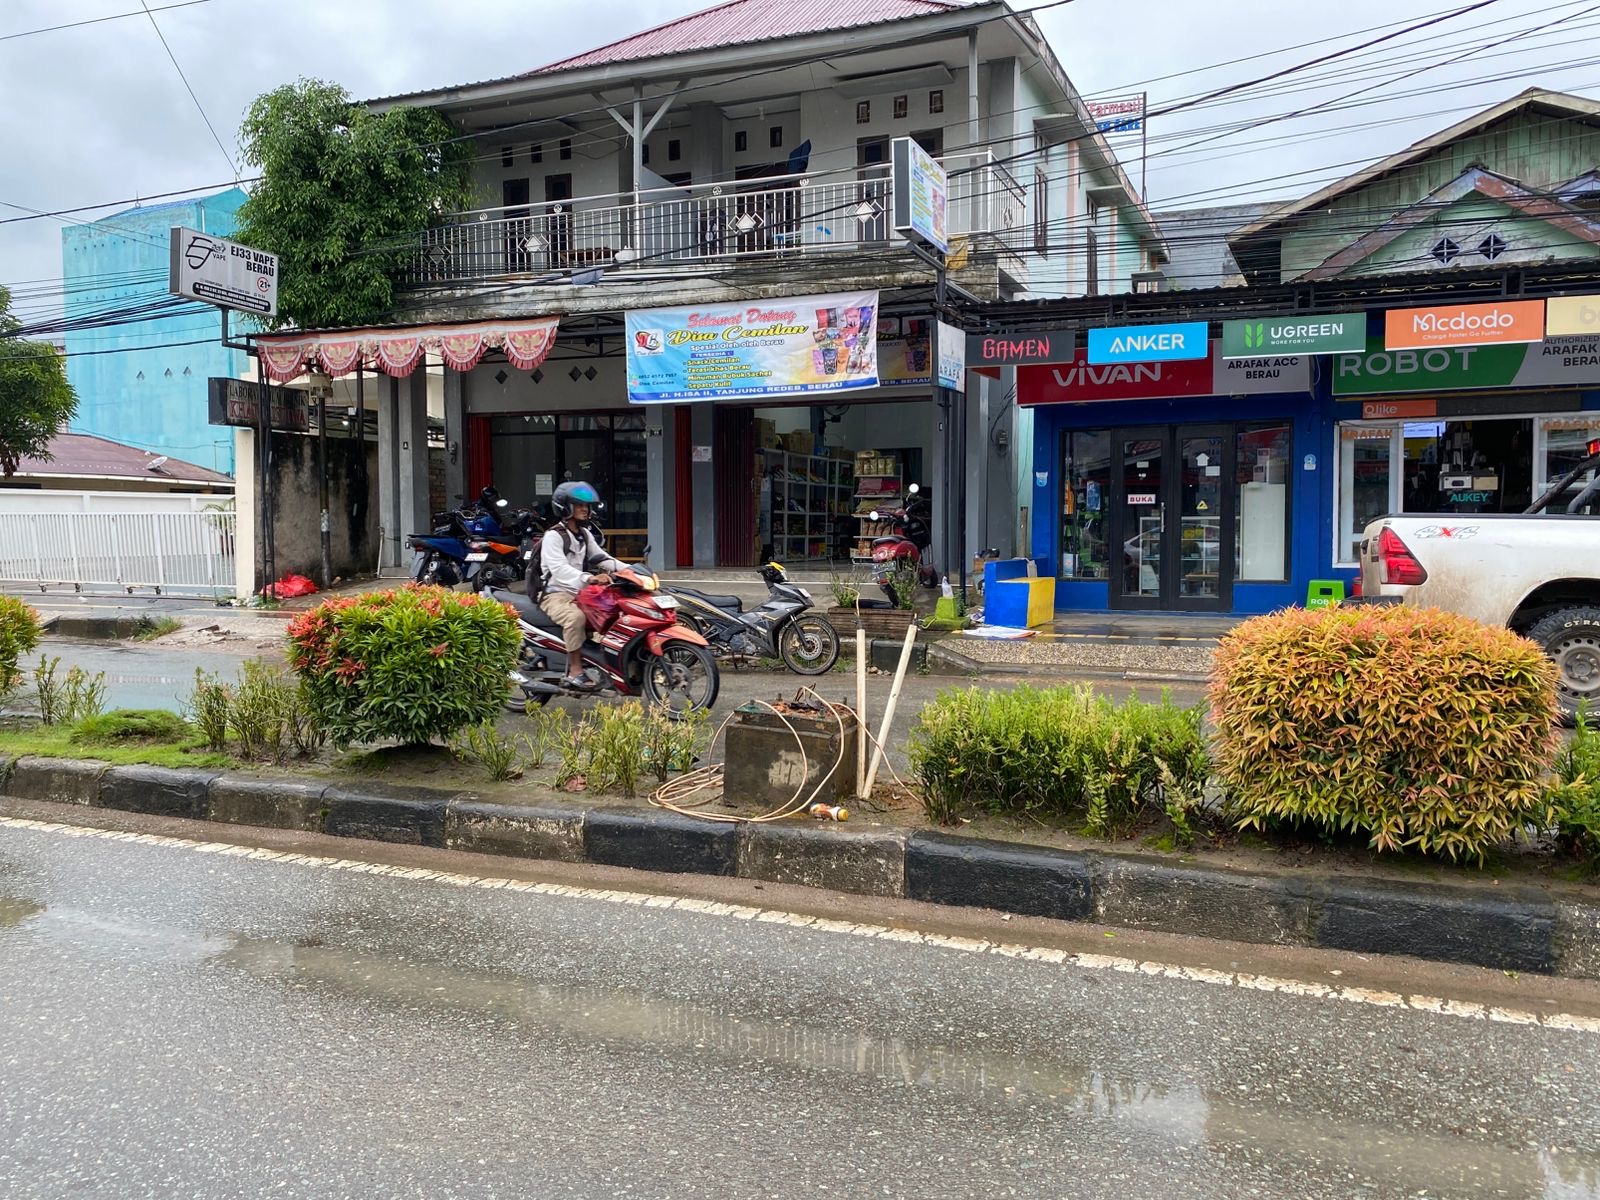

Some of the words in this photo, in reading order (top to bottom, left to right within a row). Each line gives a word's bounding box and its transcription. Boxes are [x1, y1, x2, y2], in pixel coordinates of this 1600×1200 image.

[212, 253, 226, 261] VAPE
[231, 246, 251, 260] EJ33
[253, 251, 275, 267] VAPE
[246, 261, 274, 277] BERAU
[260, 280, 271, 289] 21+
[688, 312, 742, 329] Selamat
[746, 307, 797, 325] Datang
[1412, 309, 1514, 333] Mcdodo
[722, 323, 809, 343] Cemilan
[1271, 323, 1343, 338] UGREEN
[1423, 333, 1447, 341] Charge
[690, 343, 719, 352] Spesial
[761, 338, 785, 347] Berau
[1109, 333, 1185, 354] ANKER
[1544, 336, 1599, 344] AUTHORIZED
[982, 335, 1050, 361] GAMEN
[1542, 344, 1597, 356] ARAFAK
[1228, 359, 1270, 369] ARAFAK
[1273, 357, 1299, 367] ACC
[1340, 348, 1477, 377] ROBOT
[1563, 356, 1600, 367] BERA
[688, 373, 721, 381] Minuman
[747, 370, 773, 378] Sachet
[1246, 370, 1280, 380] BERAU
[688, 382, 714, 390] Sepatu
[716, 387, 764, 396] TANJUNG
[766, 384, 805, 393] REDEB,
[808, 382, 843, 390] BERAU
[1450, 493, 1489, 502] AUKEY
